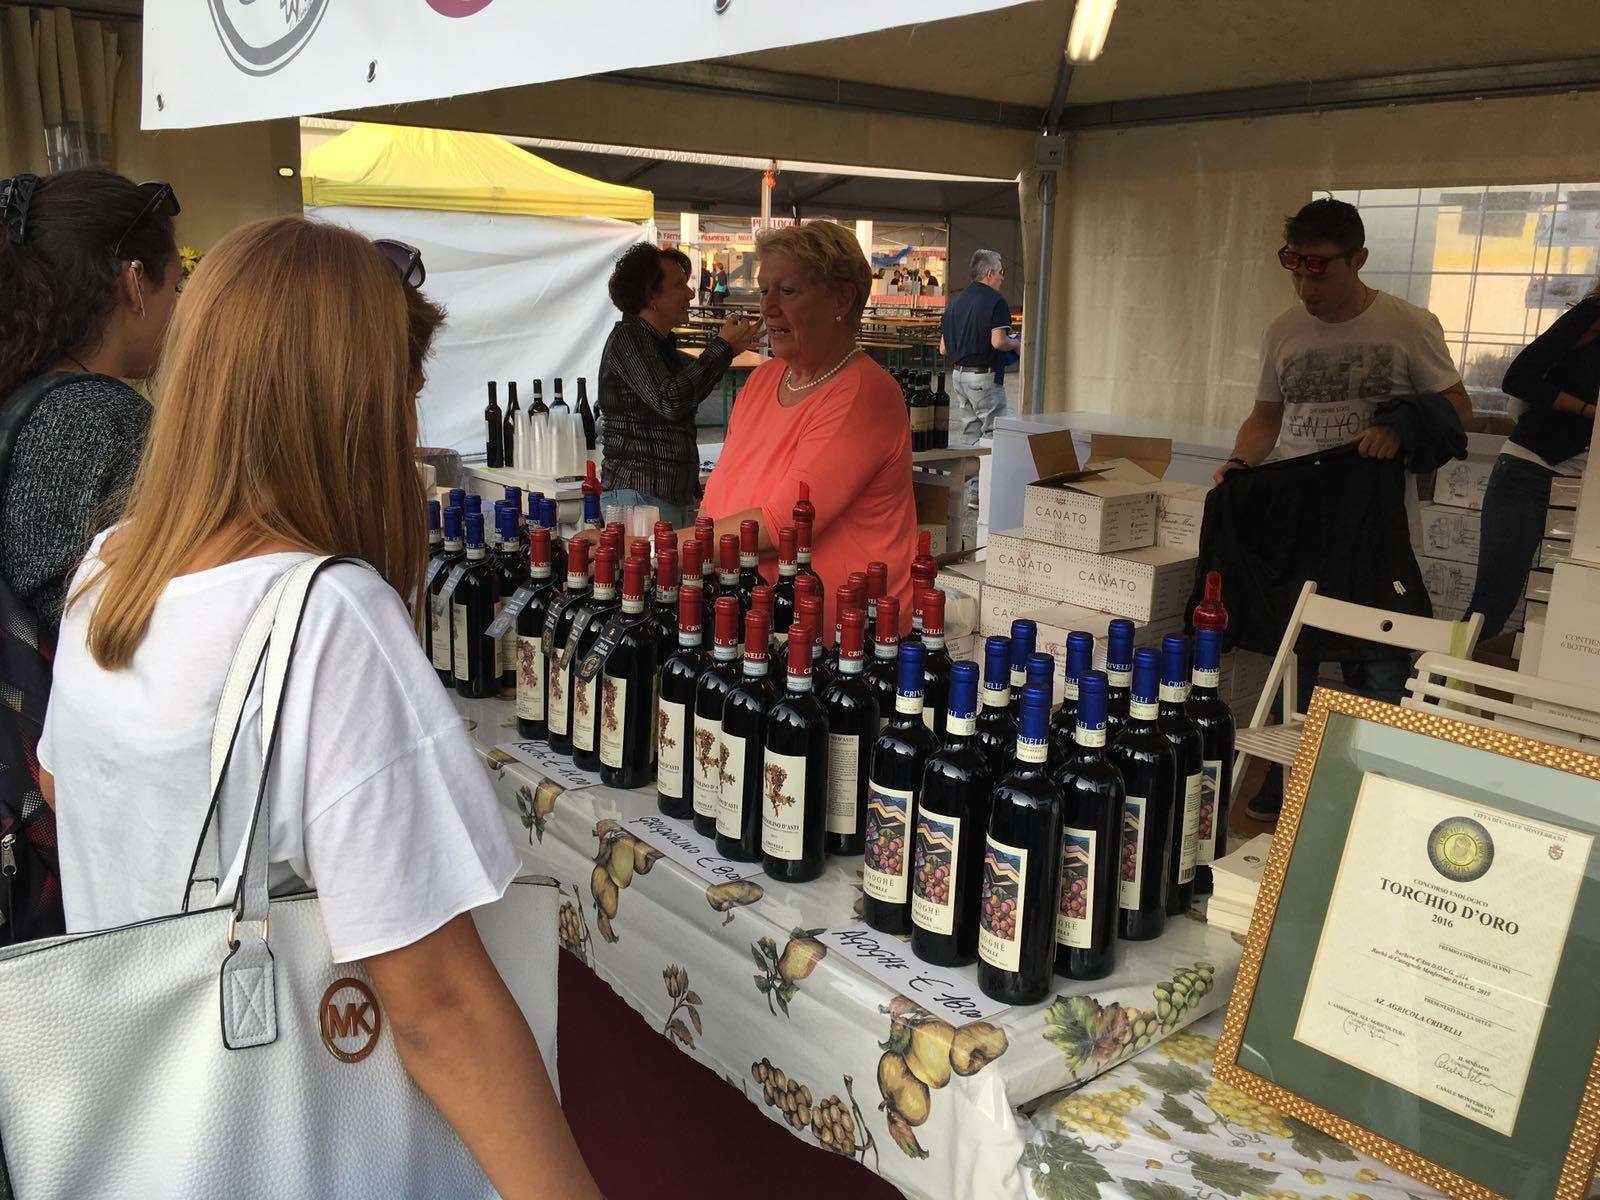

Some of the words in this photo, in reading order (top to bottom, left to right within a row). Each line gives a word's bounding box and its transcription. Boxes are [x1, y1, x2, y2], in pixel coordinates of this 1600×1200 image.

[1035, 505, 1087, 525] CANATO
[998, 553, 1053, 575] CANATO
[1078, 570, 1137, 592] CANATO
[1523, 826, 1567, 843] MONFERRATO
[1413, 878, 1449, 895] CONCORSO
[1449, 890, 1489, 908] ENOLOGICO
[1380, 877, 1458, 915] TORCHIO
[1461, 905, 1520, 936] D'ORO
[1432, 913, 1454, 928] 2016
[1438, 943, 1460, 955] PREMIO
[1422, 965, 1453, 984] Monferrato
[327, 1001, 374, 1040] MK
[1386, 1000, 1425, 1024] AGRICOLA
[1424, 1015, 1464, 1038] CRIVELLI
[1455, 1008, 1475, 1021] DALLA
[1435, 1084, 1457, 1099] CASALE
[1457, 1091, 1496, 1114] MONFERRATO
